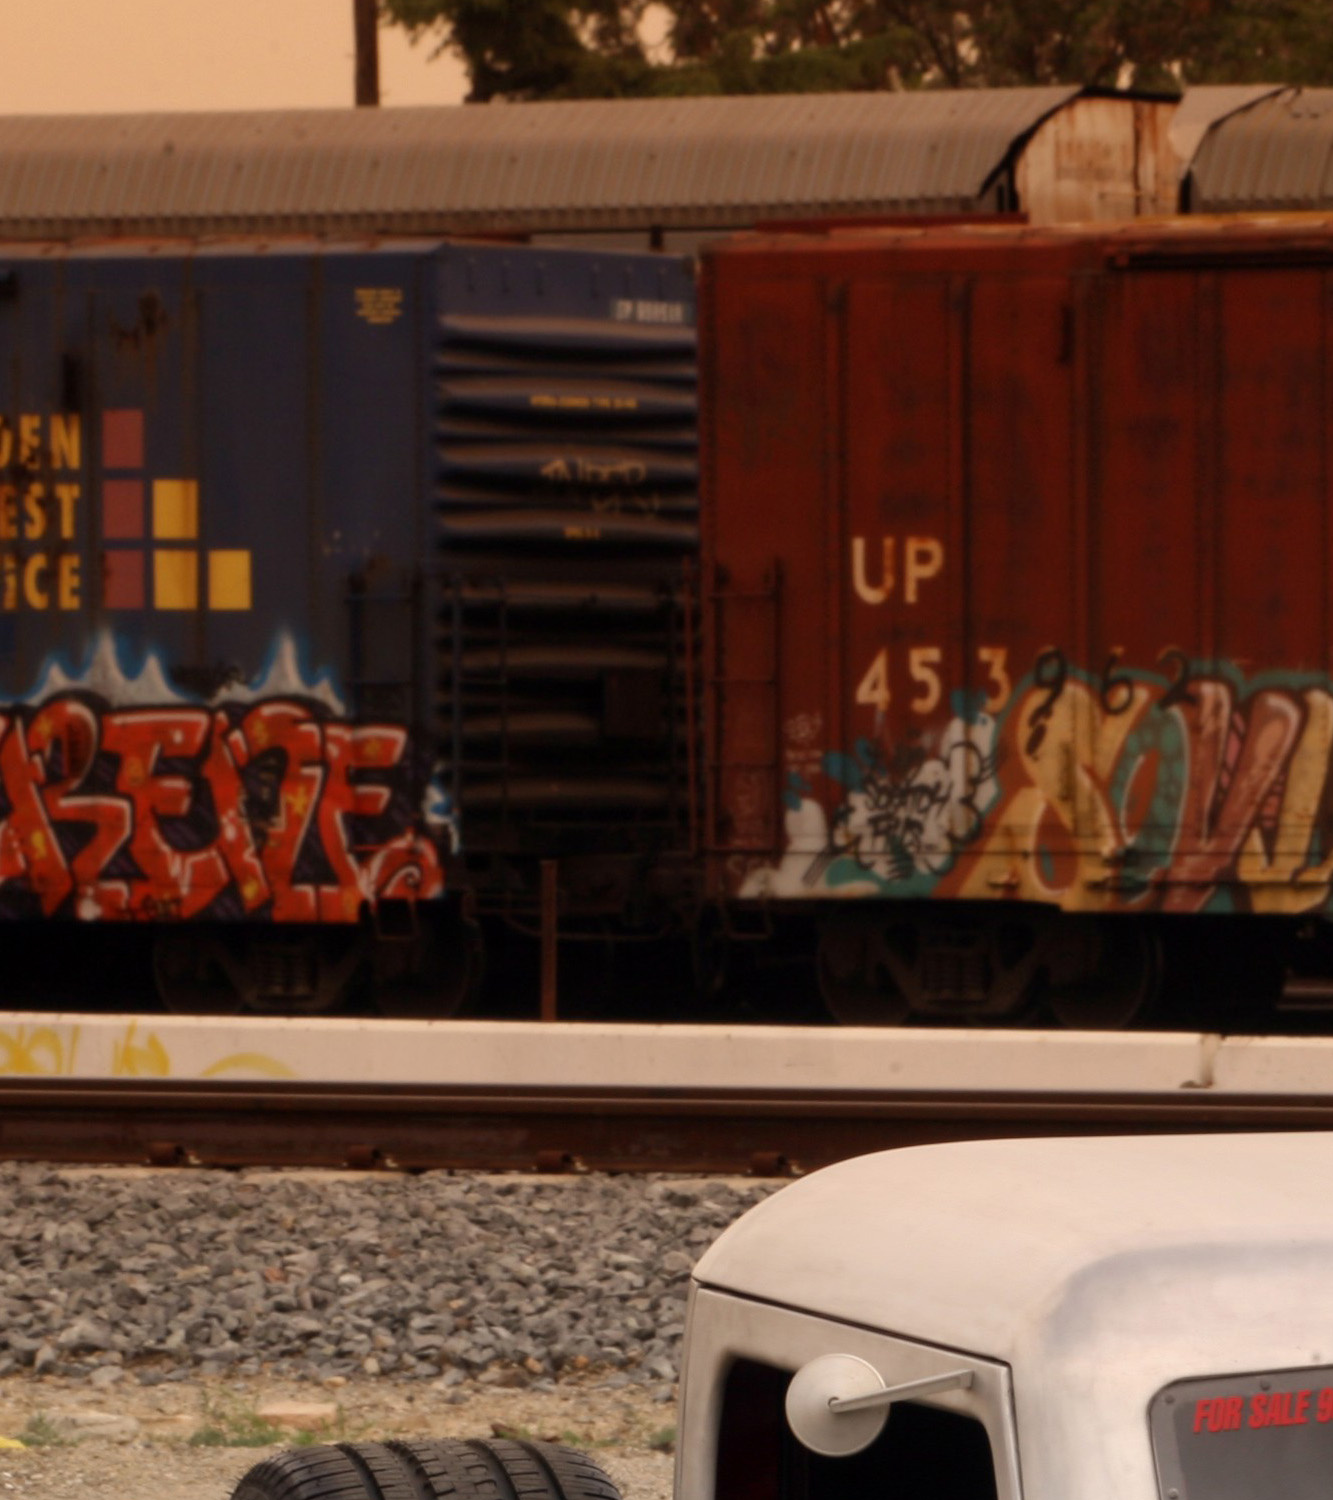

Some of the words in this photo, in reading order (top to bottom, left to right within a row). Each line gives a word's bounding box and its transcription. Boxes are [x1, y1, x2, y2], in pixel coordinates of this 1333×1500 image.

[851, 537, 944, 604] UP
[1193, 1396, 1243, 1433] FOR
[1248, 1389, 1311, 1429] SALE
